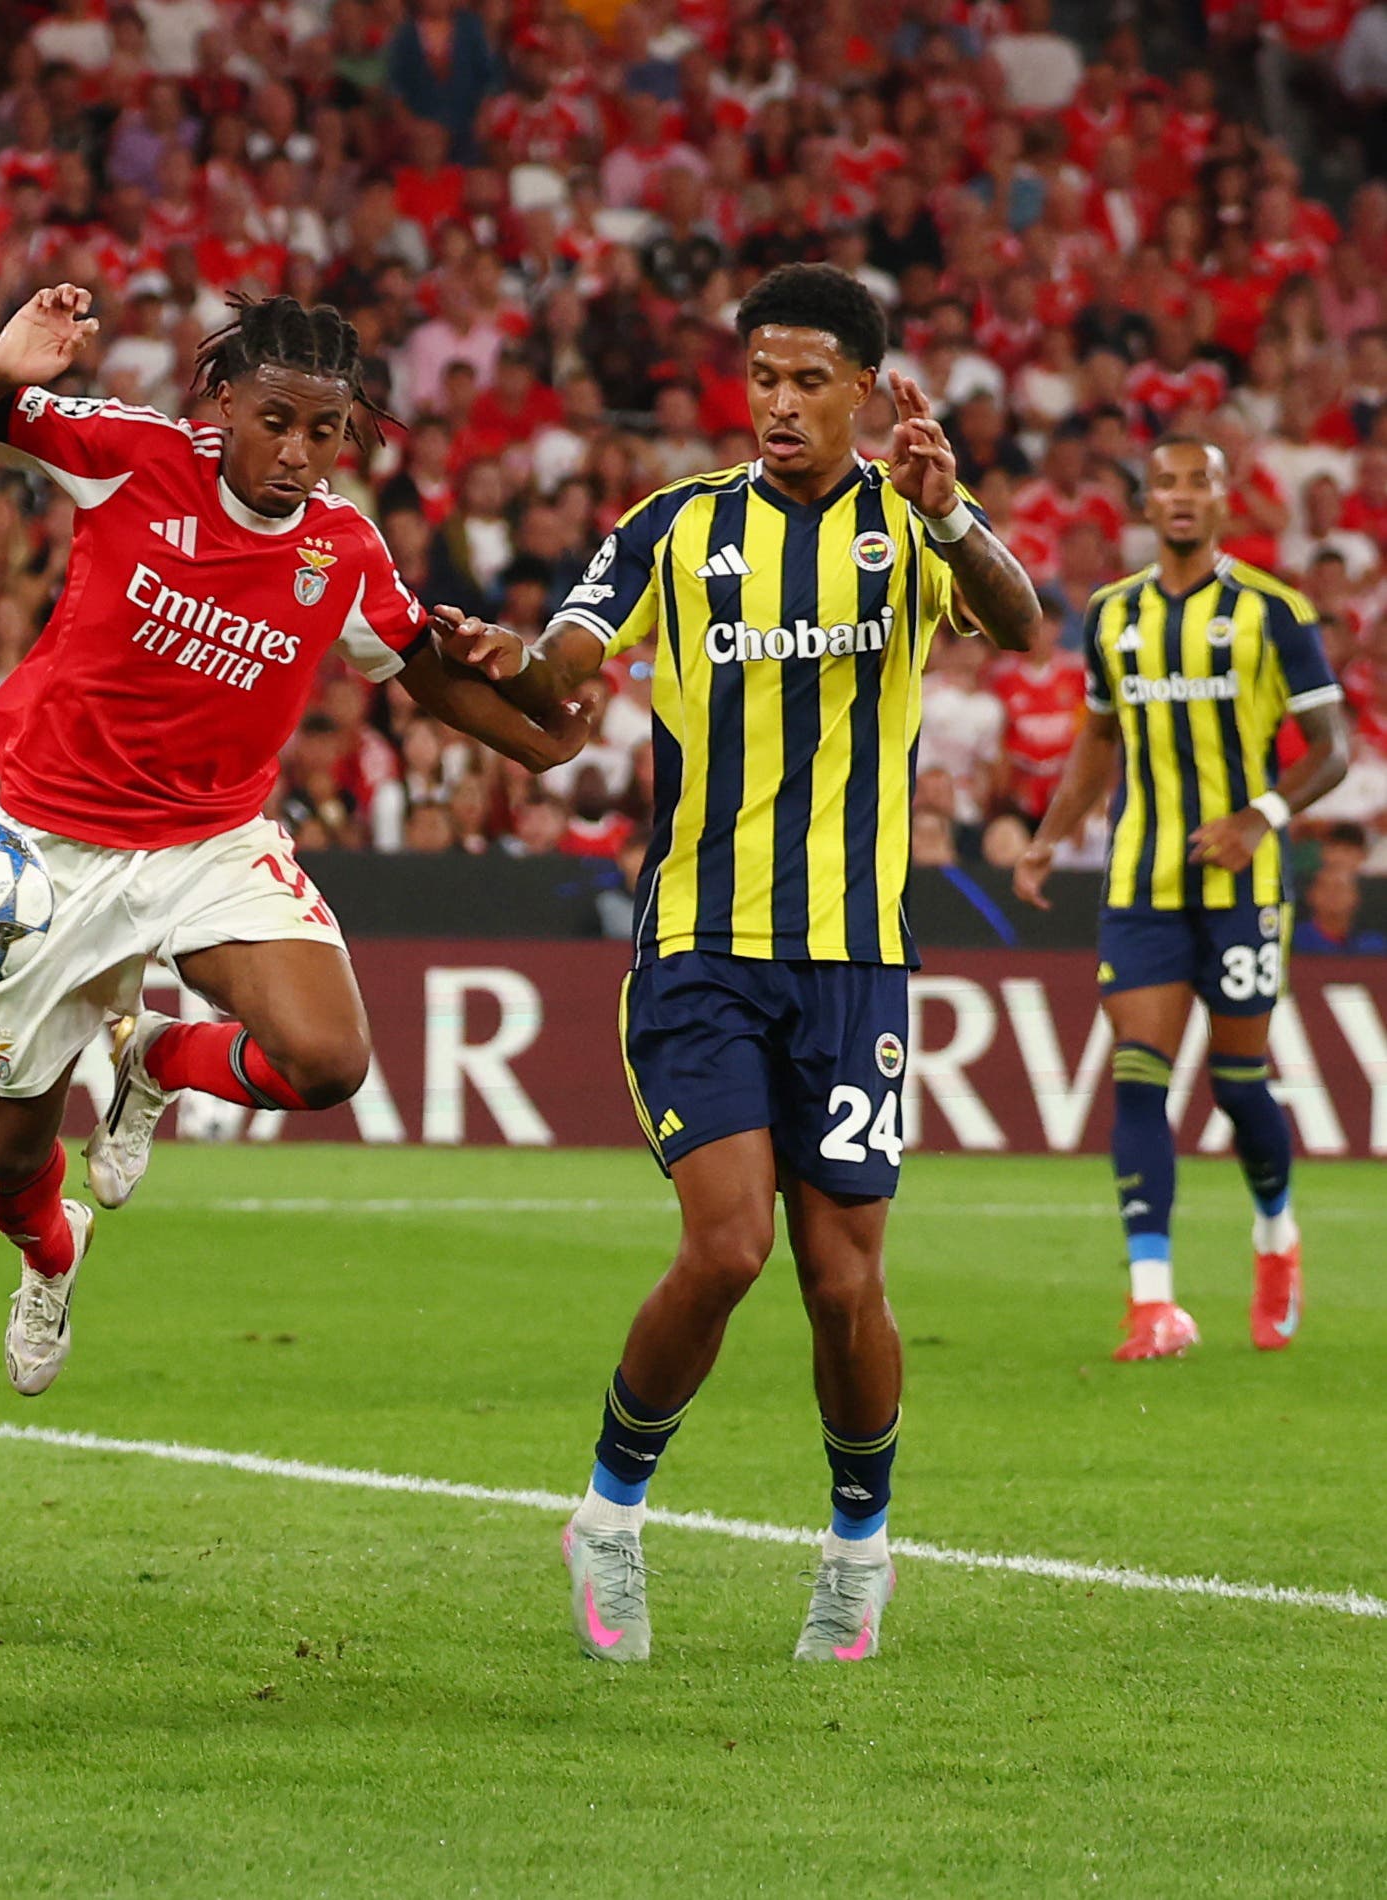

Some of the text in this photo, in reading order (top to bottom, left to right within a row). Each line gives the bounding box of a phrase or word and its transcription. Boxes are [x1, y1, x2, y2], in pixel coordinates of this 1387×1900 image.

[125, 562, 301, 665] Emirates
[706, 605, 894, 664] Chobani
[132, 620, 264, 691] FLY BETTER
[1220, 941, 1280, 999] 33
[819, 1084, 904, 1167] 24
